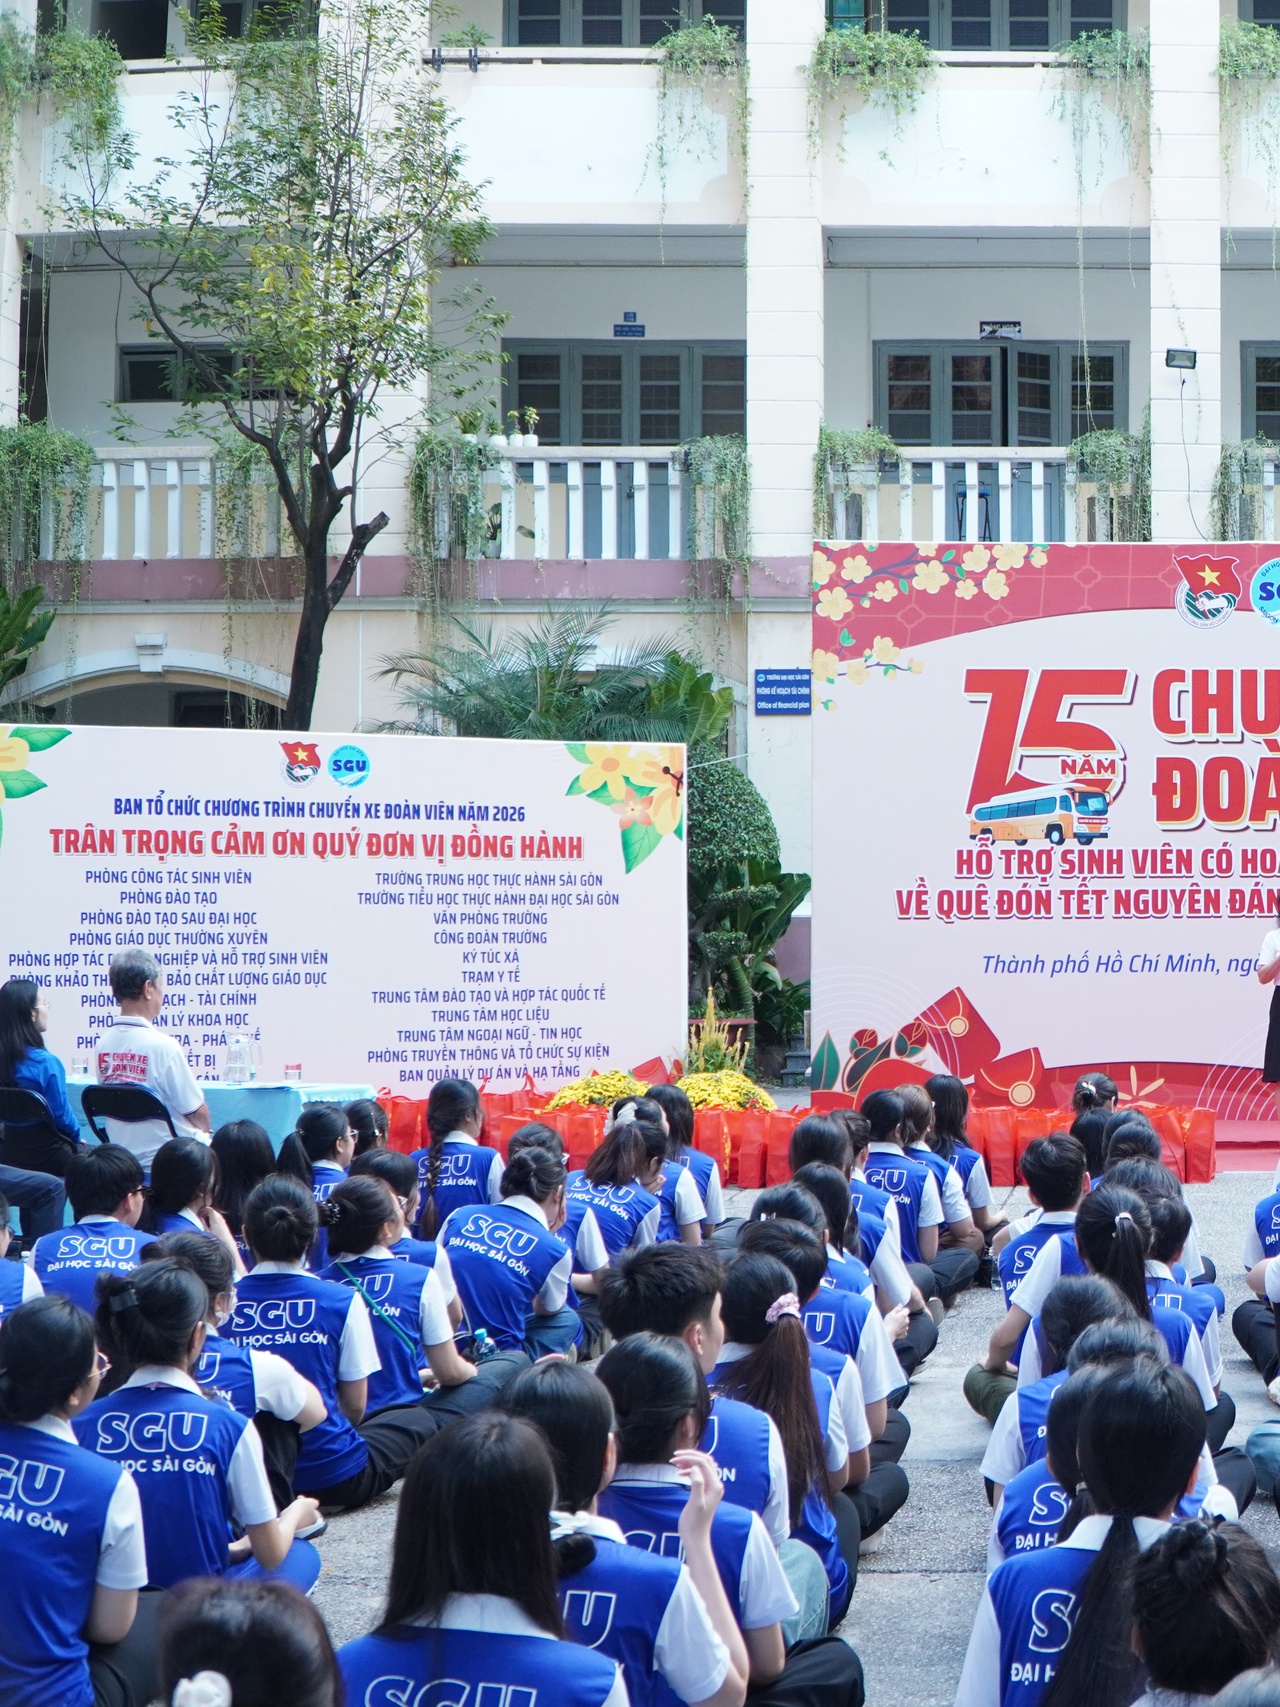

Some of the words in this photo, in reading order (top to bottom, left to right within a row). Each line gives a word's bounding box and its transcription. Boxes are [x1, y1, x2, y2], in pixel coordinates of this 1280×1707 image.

[964, 669, 1129, 814] 15
[332, 759, 366, 772] SGU
[1061, 754, 1116, 775] NĂM
[49, 823, 114, 853] TRÂN
[122, 829, 203, 860] TRỌNG
[211, 822, 264, 854] CẢM
[272, 829, 304, 855] ƠN
[313, 826, 360, 859] QUÝ
[366, 831, 414, 856] ĐƠN
[421, 834, 444, 863] VỊ
[450, 824, 513, 858] ĐỒNG
[520, 830, 581, 858] HÀNH
[957, 837, 992, 875] HỖ
[1001, 846, 1053, 882] TRỢ
[1062, 849, 1123, 875] SINH
[1132, 843, 1193, 875] VIÊN
[1201, 843, 1233, 874] CÓ
[85, 867, 127, 883] PHÒNG
[131, 867, 163, 883] CÔNG
[166, 867, 188, 883] TÁC
[191, 871, 220, 883] SINH
[223, 868, 251, 883] VIÊN
[120, 888, 161, 904] PHÒNG
[165, 888, 190, 904] ĐÀO
[193, 891, 217, 907] TẠO
[896, 878, 928, 915] VỀ
[937, 884, 988, 919] QUÊ
[996, 882, 1051, 915] ĐÓN
[1060, 878, 1106, 915] TẾT
[1114, 883, 1221, 915] NGUYÊN
[1228, 883, 1280, 914] ĐÁN
[433, 909, 456, 924] VĂN
[460, 909, 499, 924] PHÒNG
[502, 910, 547, 924] TRƯỜNG
[433, 929, 463, 944] CÔNG
[466, 929, 498, 944] ĐOÀN
[501, 929, 547, 943] TRƯỜNG
[462, 948, 477, 963] KÝ
[480, 948, 500, 963] TÚC
[983, 953, 1045, 974] Thành
[1050, 950, 1089, 978] phố
[1095, 949, 1123, 973] Hồ
[1129, 953, 1160, 973] Chí
[1165, 953, 1220, 975] Minh,
[461, 970, 494, 985] TRẠM
[497, 970, 504, 982] Y
[507, 964, 520, 982] TẾ
[461, 1213, 539, 1257] SGU
[449, 1237, 464, 1247] ĐẠI
[464, 1239, 488, 1254] HỌC
[488, 1250, 508, 1263] SÀI
[507, 1260, 530, 1277] GÒN
[96, 1411, 208, 1454] SGU
